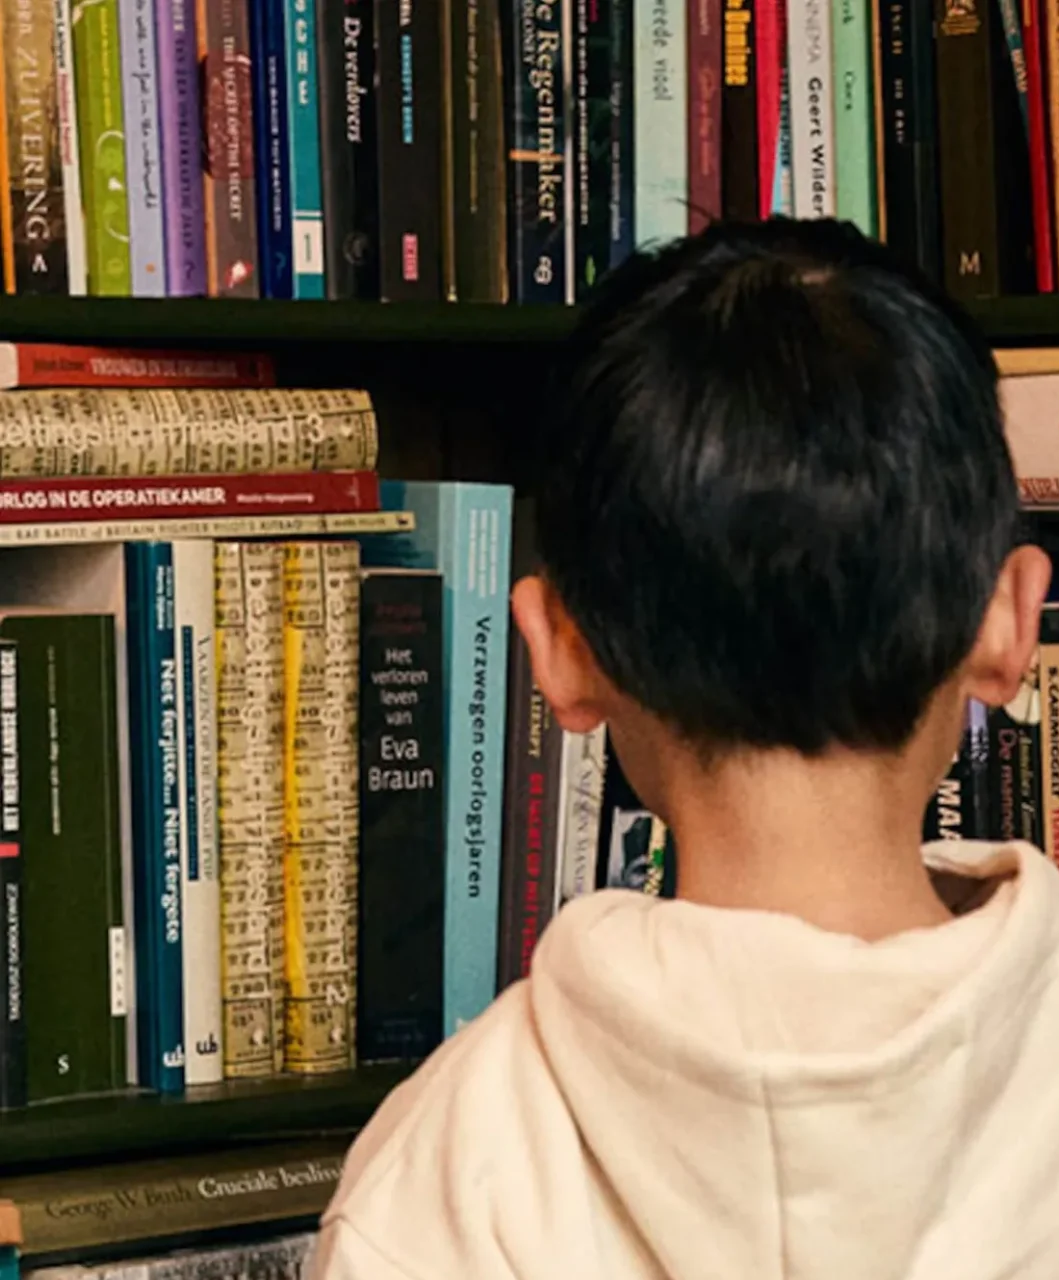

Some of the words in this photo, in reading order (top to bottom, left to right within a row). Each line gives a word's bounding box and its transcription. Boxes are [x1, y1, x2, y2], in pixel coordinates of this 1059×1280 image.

[343, 16, 362, 48] De
[346, 48, 369, 143] verdovers
[651, 58, 677, 102] viool
[807, 76, 824, 137] Geert
[17, 45, 50, 241] ZUIVERING
[810, 144, 828, 218] Wilder
[50, 489, 67, 508] IN
[68, 488, 90, 508] DE
[91, 486, 227, 508] OPERATIEKAMER
[385, 648, 413, 665] Het
[160, 658, 178, 704] Net
[371, 668, 429, 685] verloren
[468, 616, 493, 745] Verzwegen
[380, 689, 418, 706] leven
[385, 710, 413, 726] van
[380, 734, 420, 761] Eva
[998, 728, 1017, 761] De
[366, 767, 435, 790] Braun
[464, 750, 490, 899] oorlogsjaren
[937, 778, 962, 841] MAA
[163, 808, 181, 859] Niet
[198, 1168, 281, 1200] Cruciale
